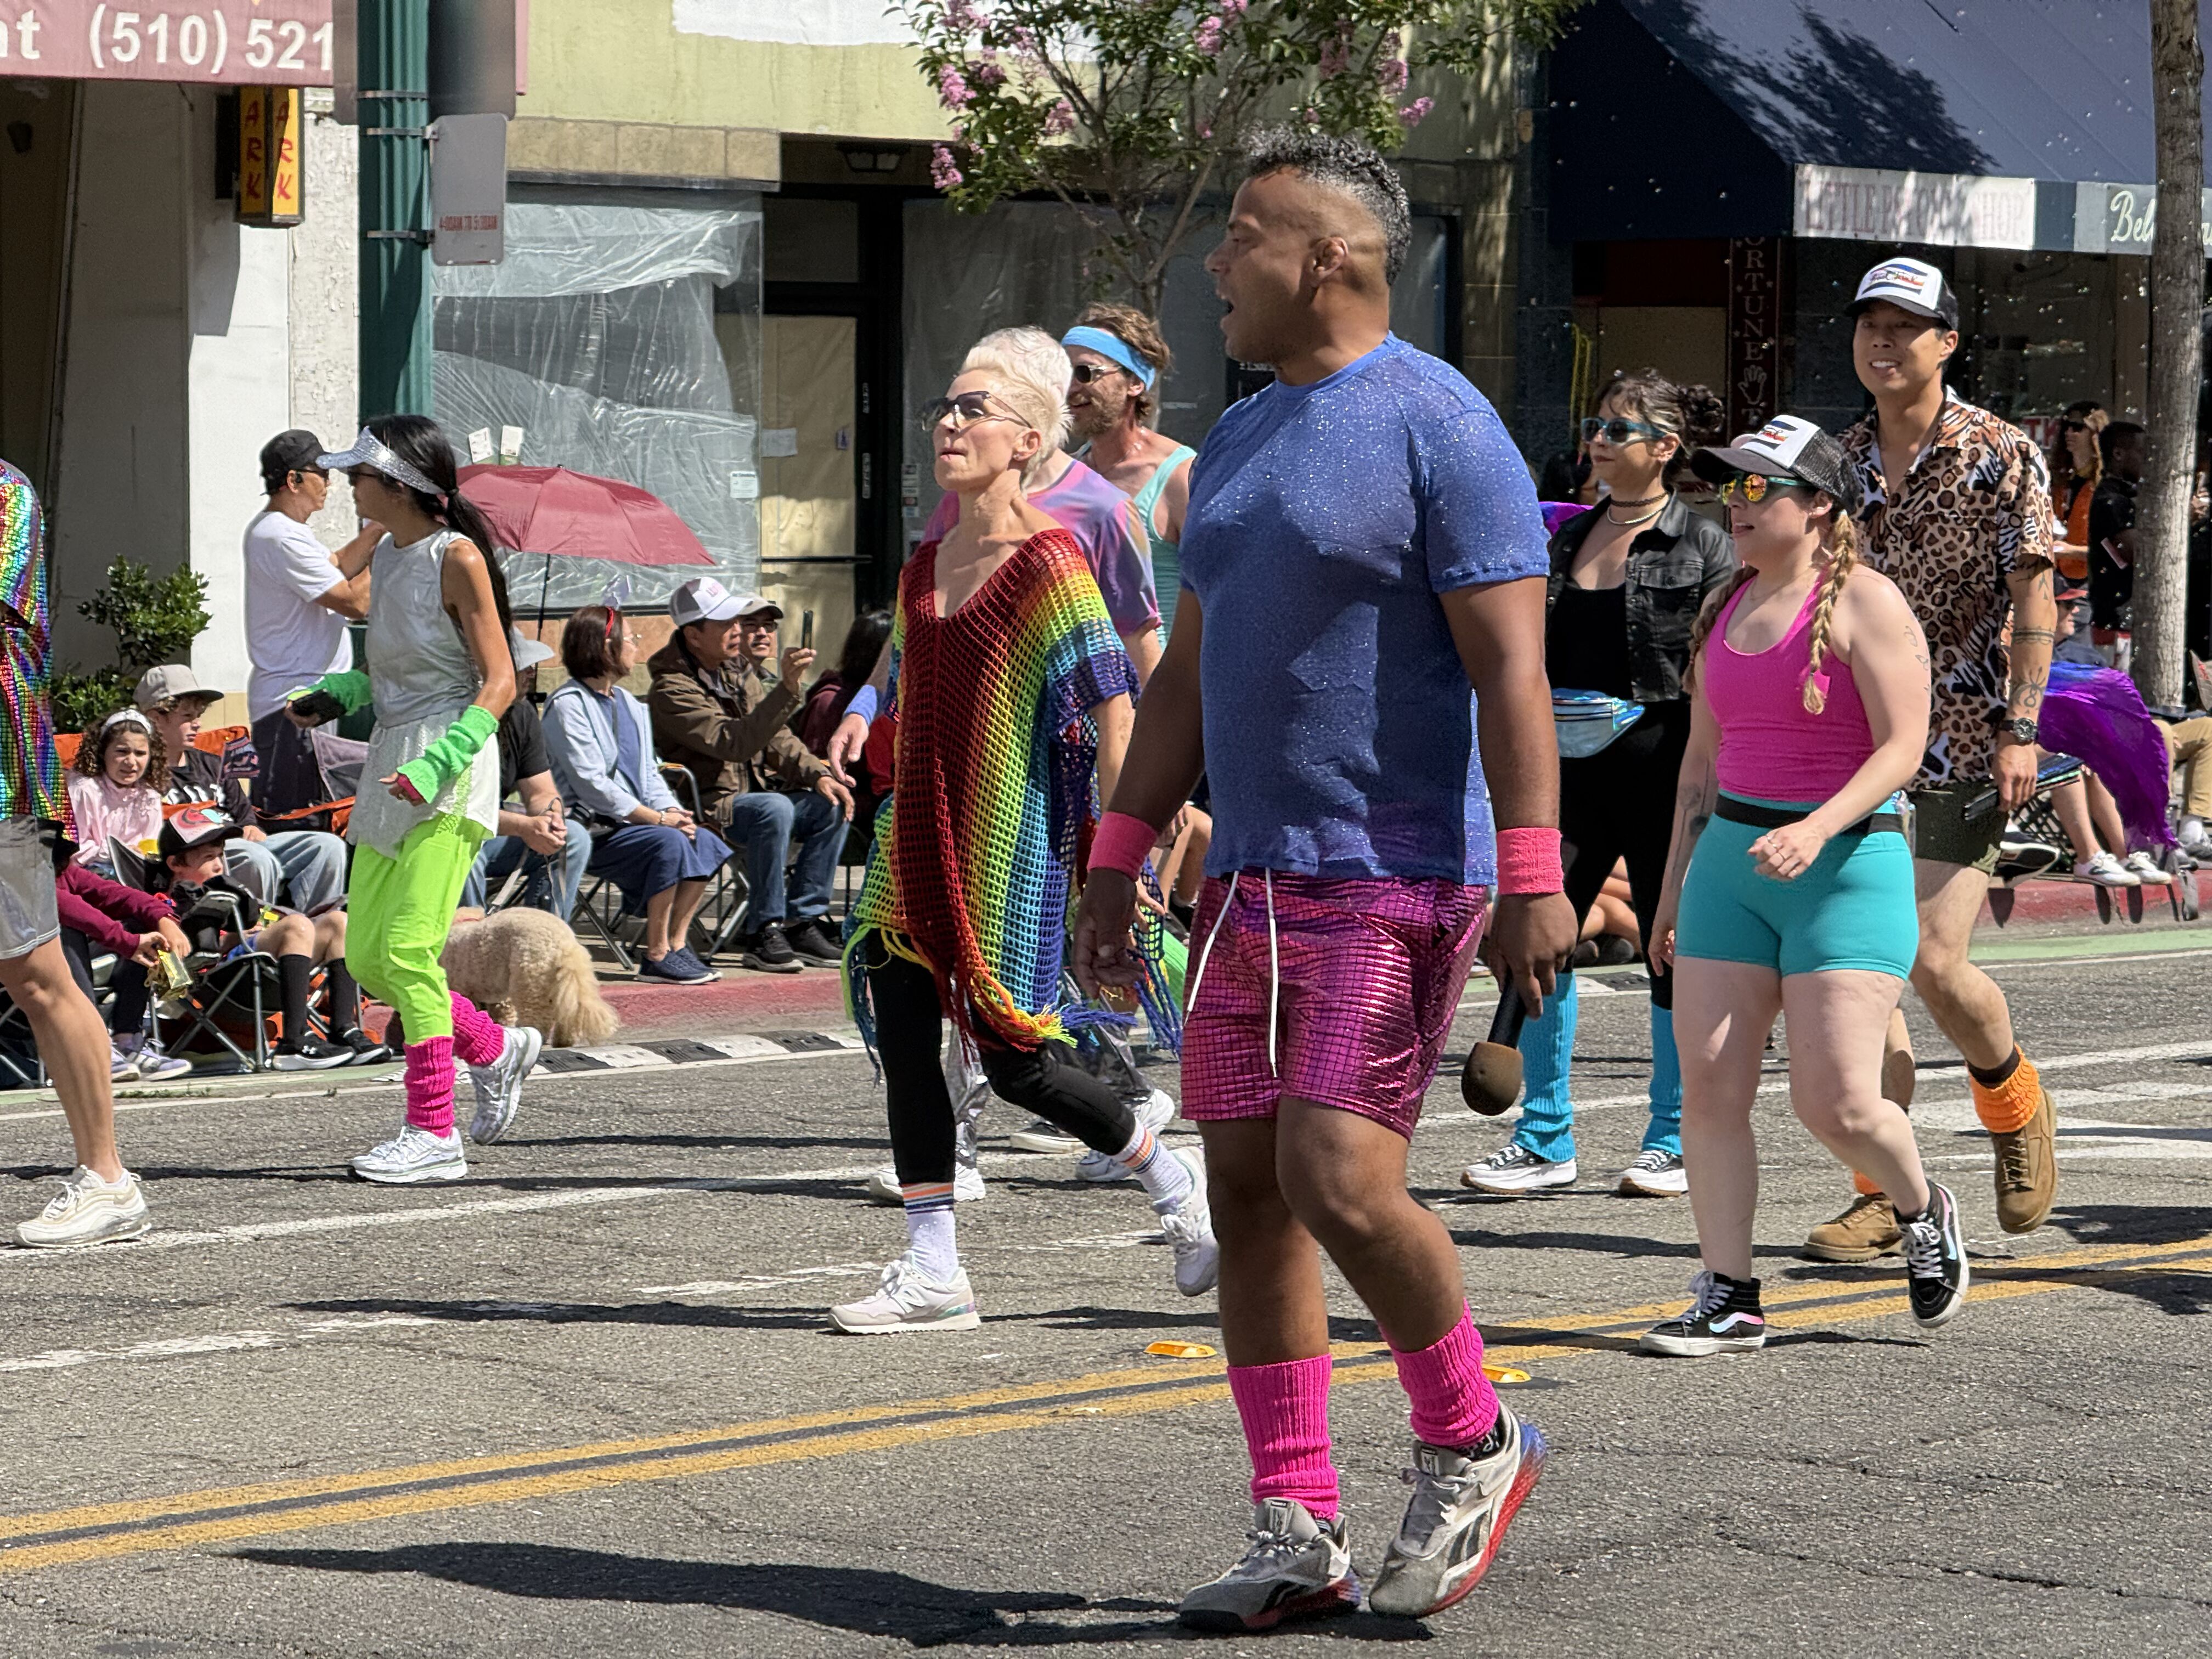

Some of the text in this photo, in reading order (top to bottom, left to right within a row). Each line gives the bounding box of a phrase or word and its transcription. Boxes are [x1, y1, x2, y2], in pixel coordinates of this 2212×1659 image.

[89, 4, 228, 74] (510)
[245, 19, 333, 70] 521
[245, 99, 262, 200] ARK
[275, 101, 292, 200] ARK
[2110, 190, 2156, 241] Bel
